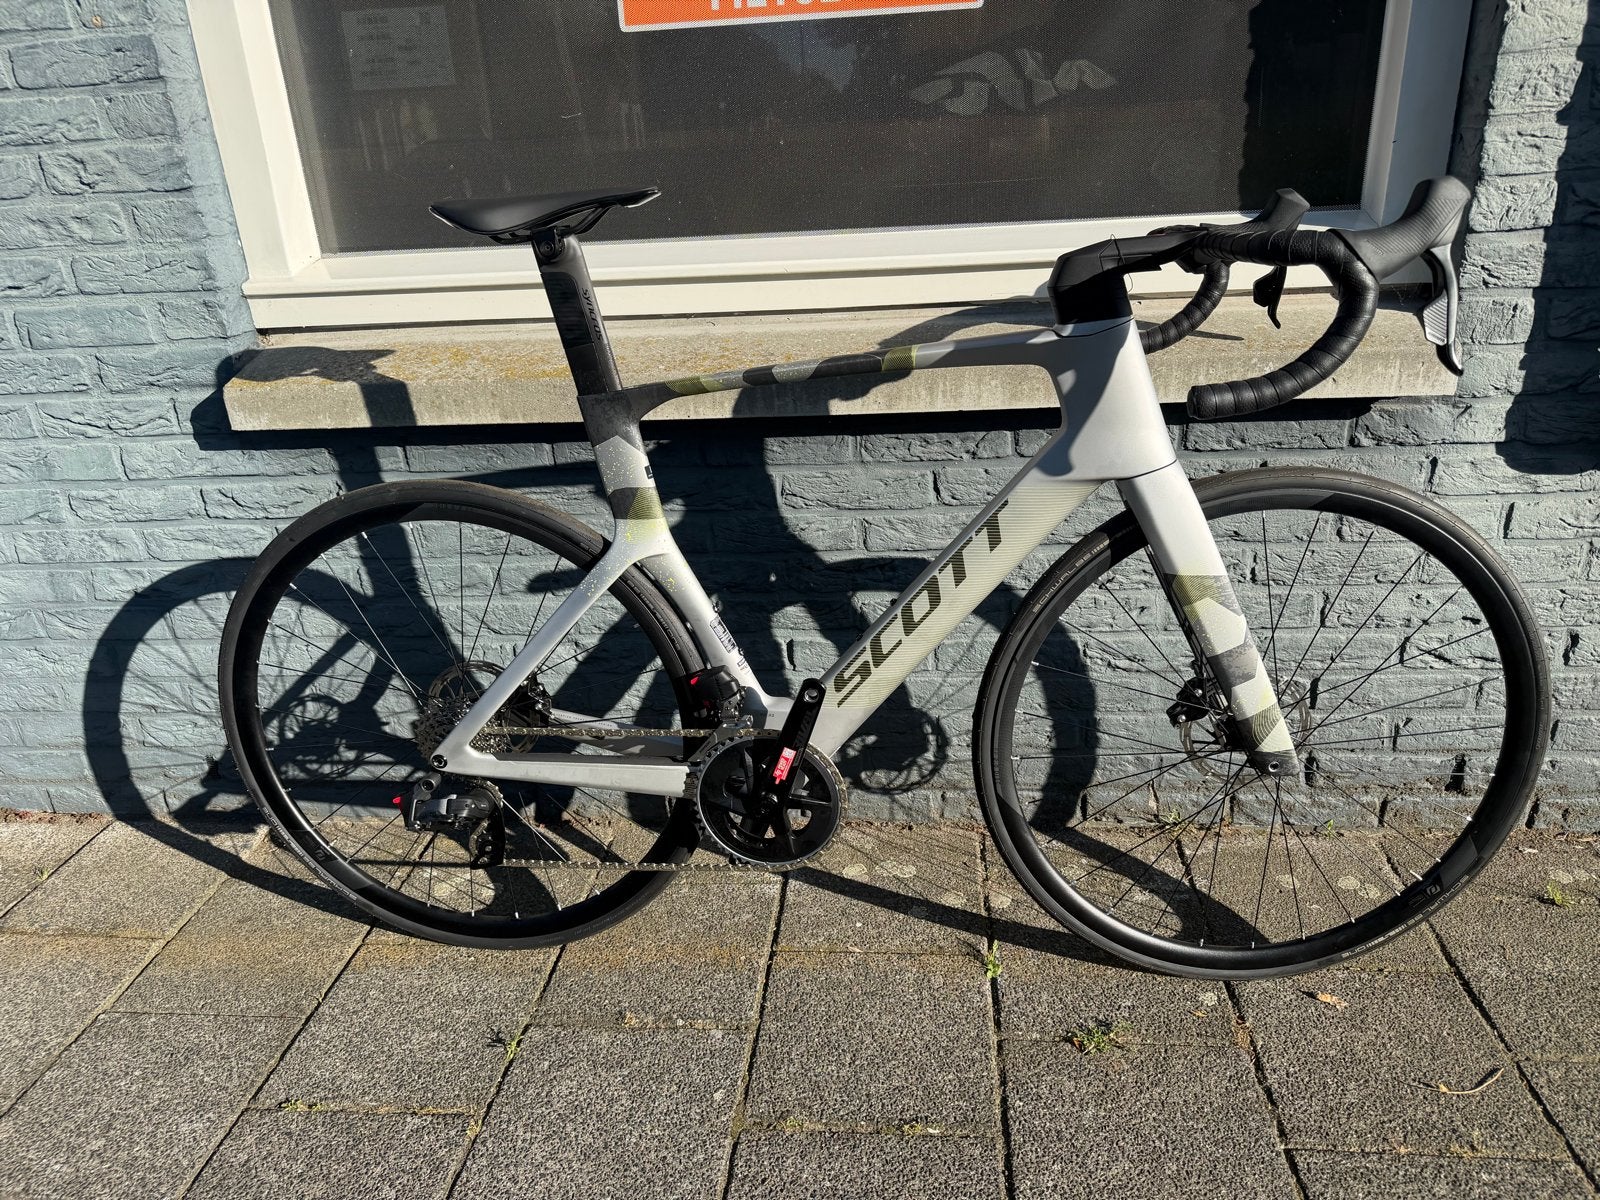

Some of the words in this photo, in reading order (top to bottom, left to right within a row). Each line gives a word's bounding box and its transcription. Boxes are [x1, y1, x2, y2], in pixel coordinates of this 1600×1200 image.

[834, 498, 1009, 708] SCOTT
[1032, 553, 1091, 613] SCHWALBE
[1406, 875, 1469, 927] SCHWALBE
